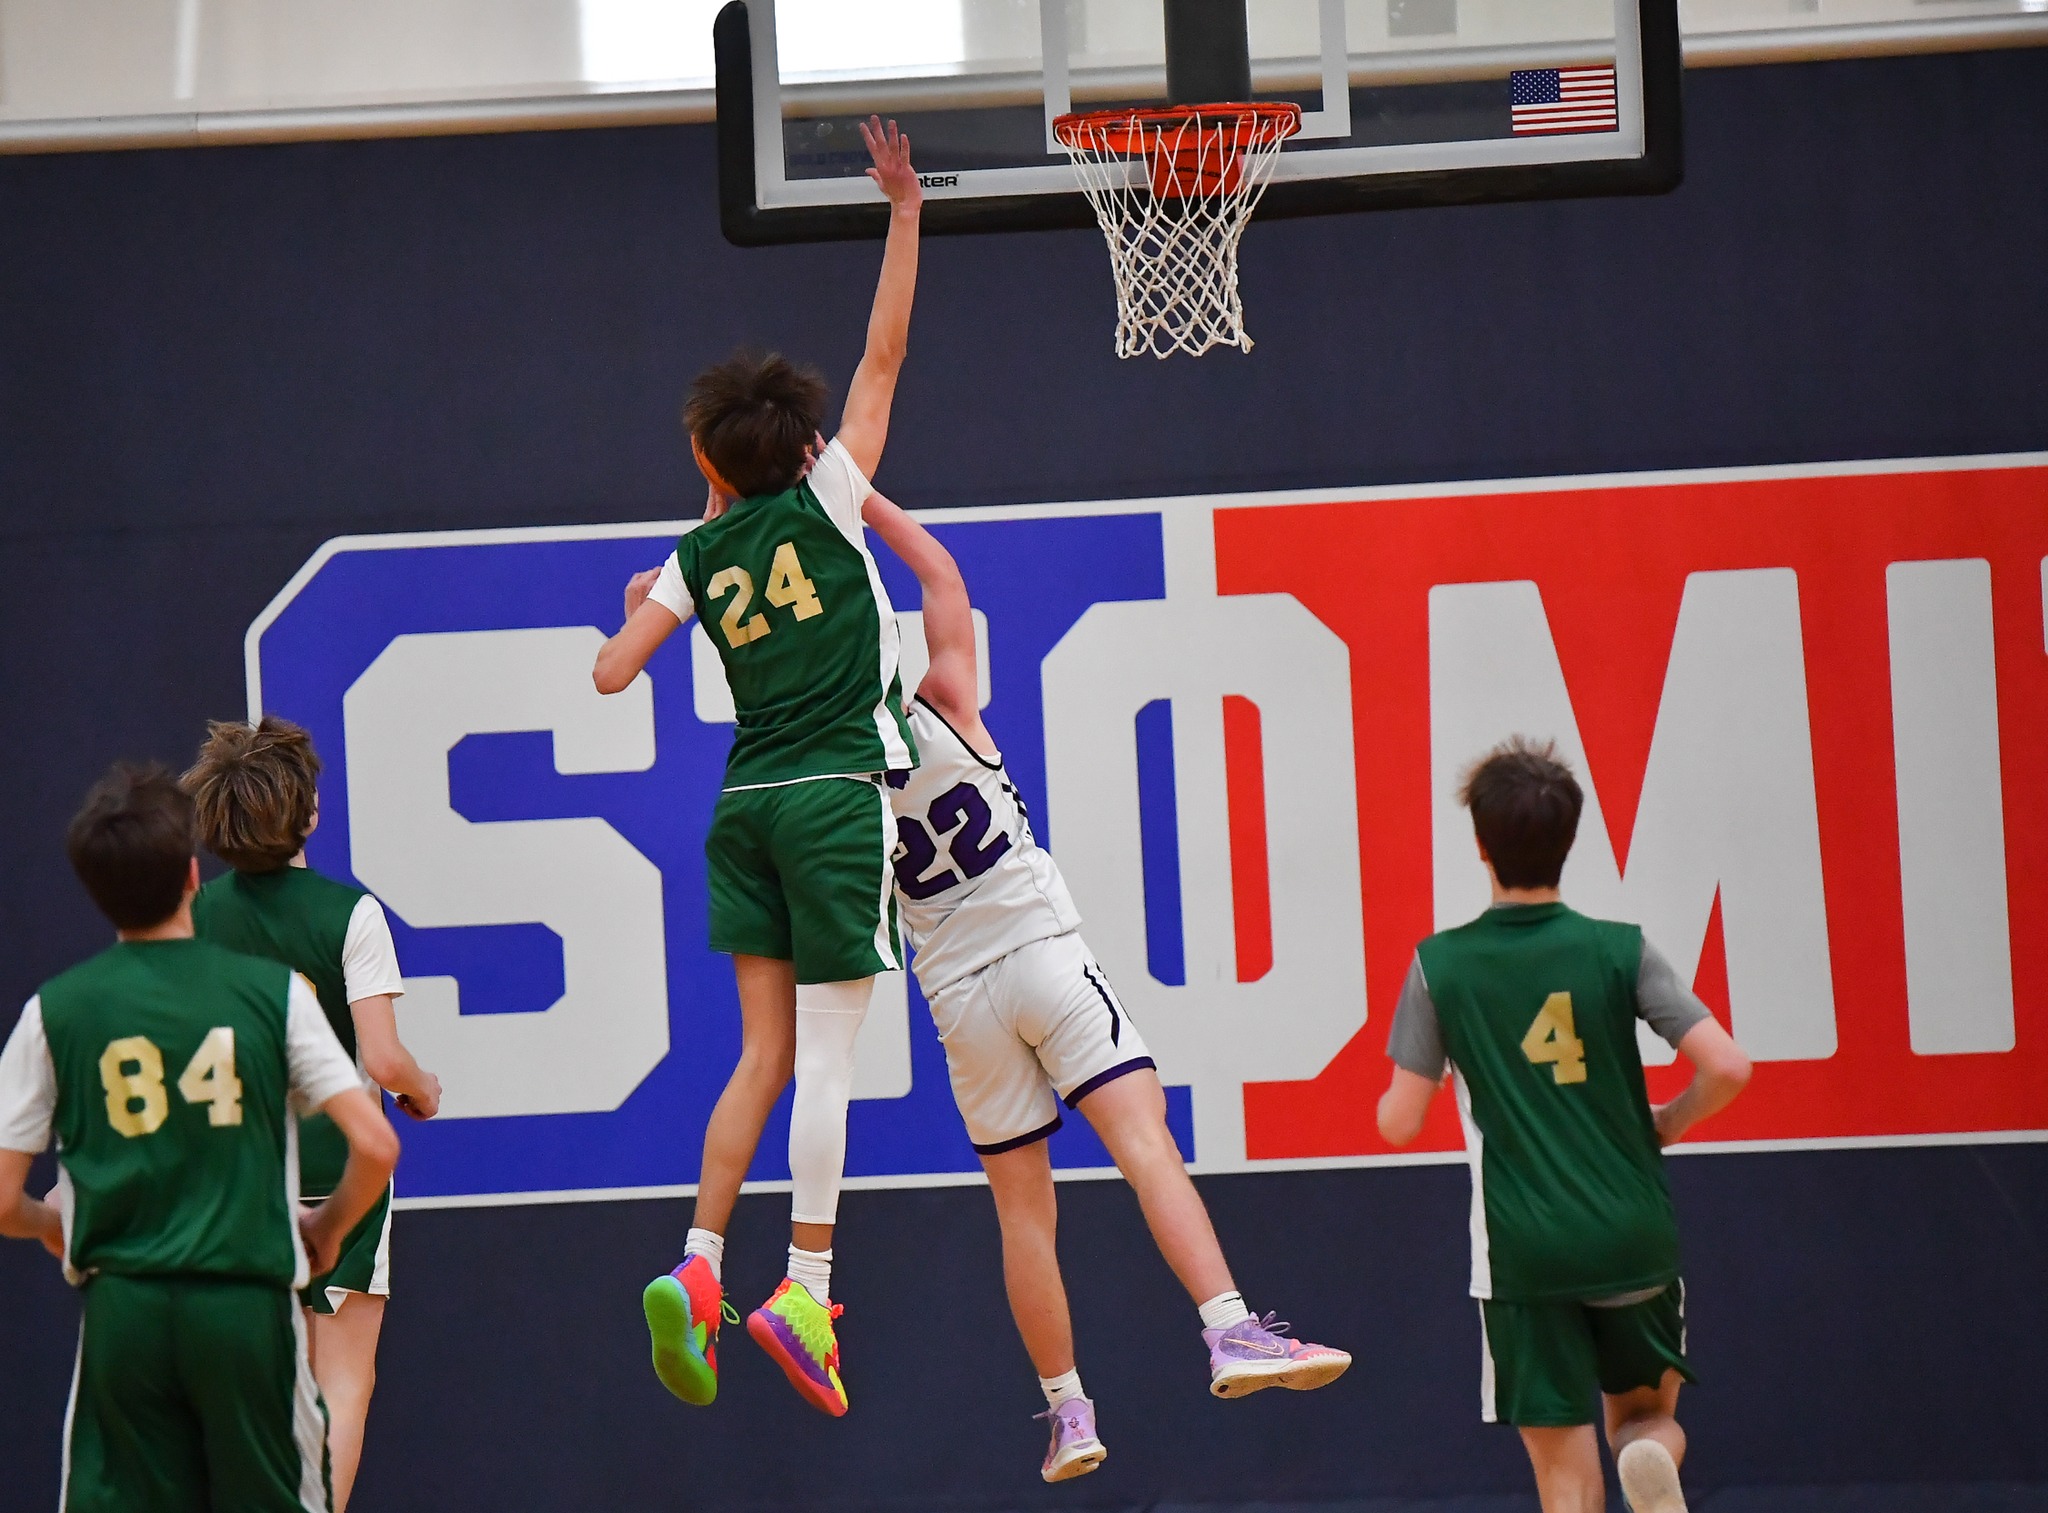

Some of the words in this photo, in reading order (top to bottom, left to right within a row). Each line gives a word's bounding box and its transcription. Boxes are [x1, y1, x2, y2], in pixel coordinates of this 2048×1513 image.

[707, 542, 823, 649] 24
[890, 782, 1013, 900] 22
[98, 1026, 243, 1139] 84
[1521, 991, 1587, 1085] 4
